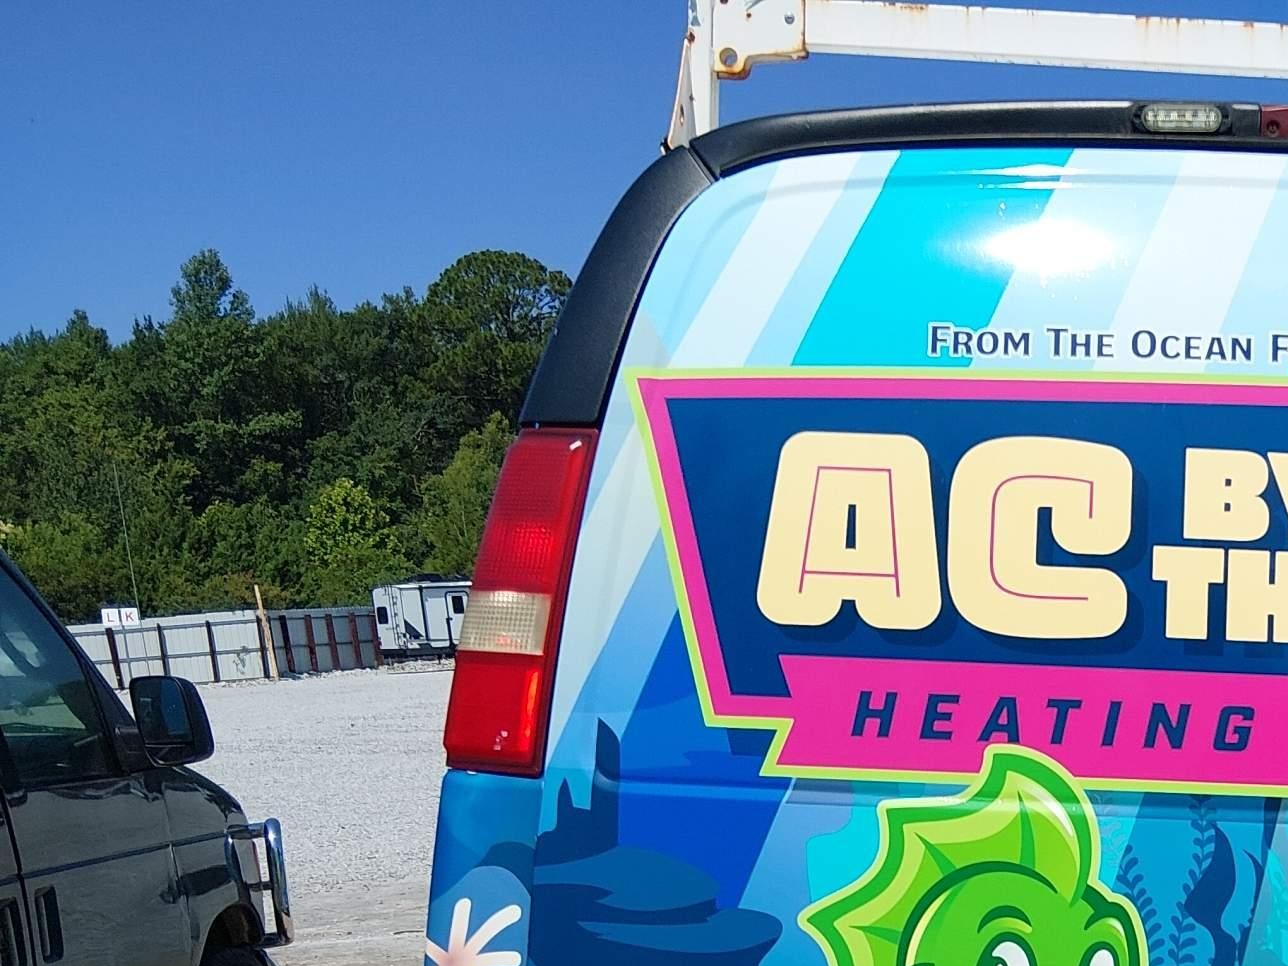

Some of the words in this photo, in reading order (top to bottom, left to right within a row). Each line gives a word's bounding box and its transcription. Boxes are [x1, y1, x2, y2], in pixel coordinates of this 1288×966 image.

[929, 325, 1031, 358] FROM
[1046, 327, 1115, 359] THE
[1131, 329, 1253, 362] OCEAN
[756, 430, 1134, 639] AC
[125, 611, 134, 622] K
[850, 690, 1256, 753] HEATING
